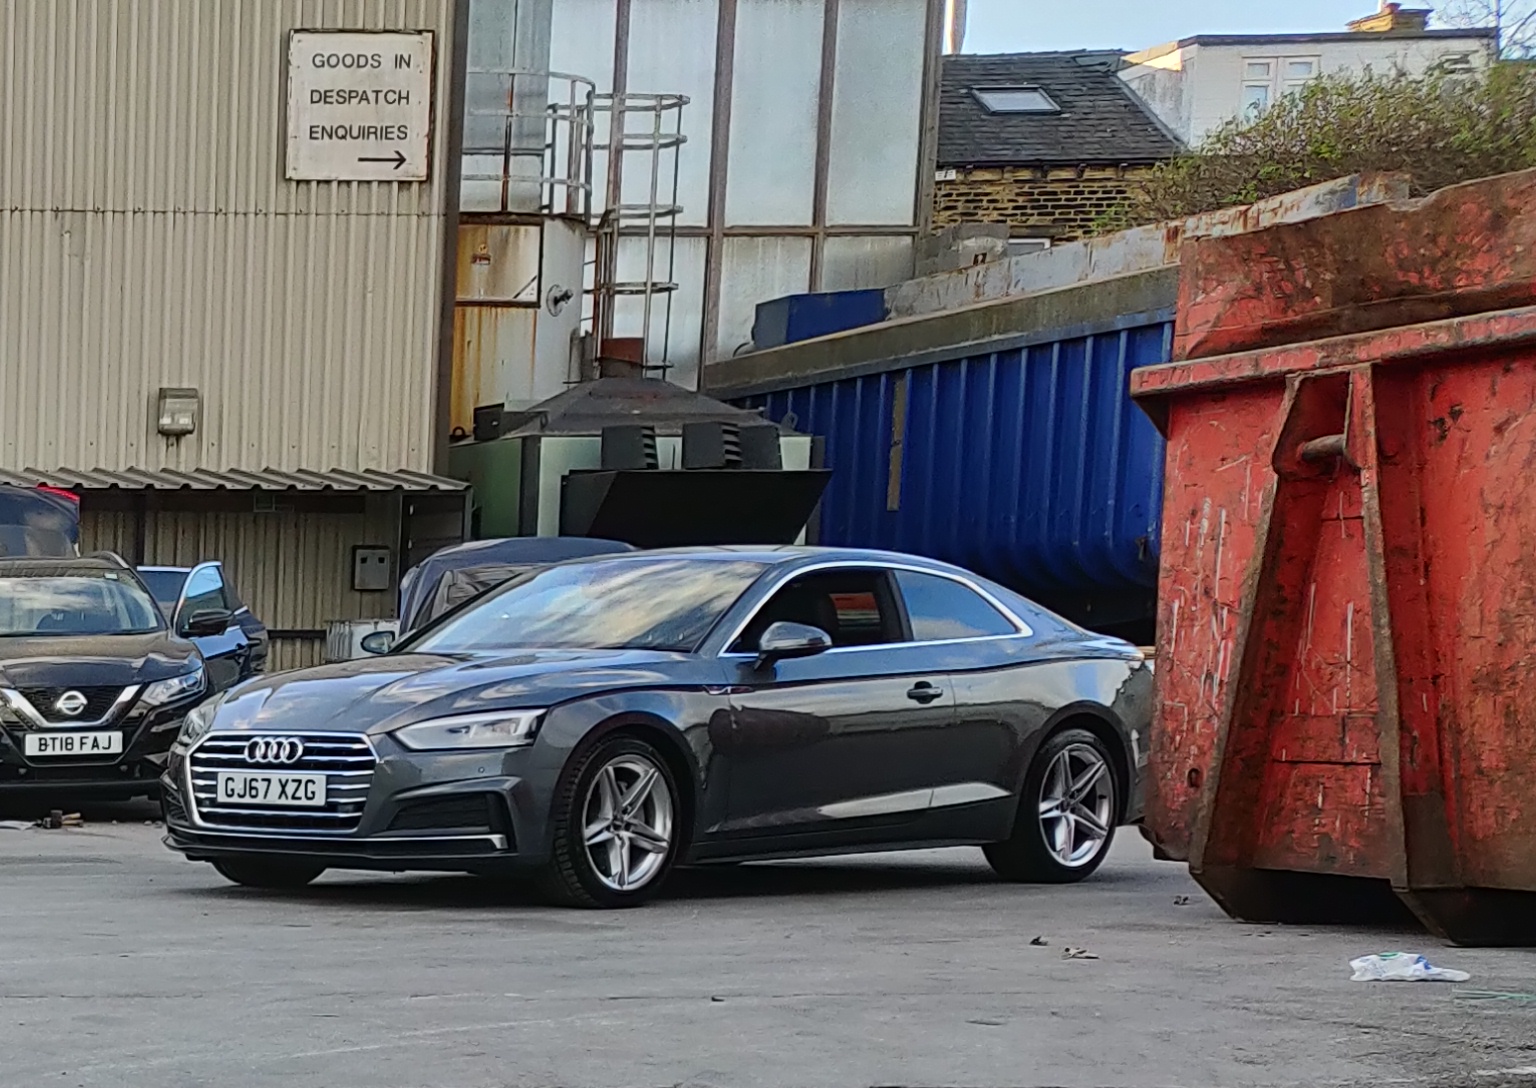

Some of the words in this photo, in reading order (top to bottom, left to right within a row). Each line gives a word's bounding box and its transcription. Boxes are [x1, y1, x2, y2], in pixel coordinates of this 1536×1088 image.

[311, 53, 382, 69] GOODS
[394, 53, 412, 70] IN
[310, 89, 410, 106] DESPATCH
[308, 124, 409, 141] ENQUIRIES
[38, 736, 74, 752] BT18
[79, 735, 112, 751] FAJ
[224, 776, 272, 799] GJ67
[277, 778, 316, 801] XZG
